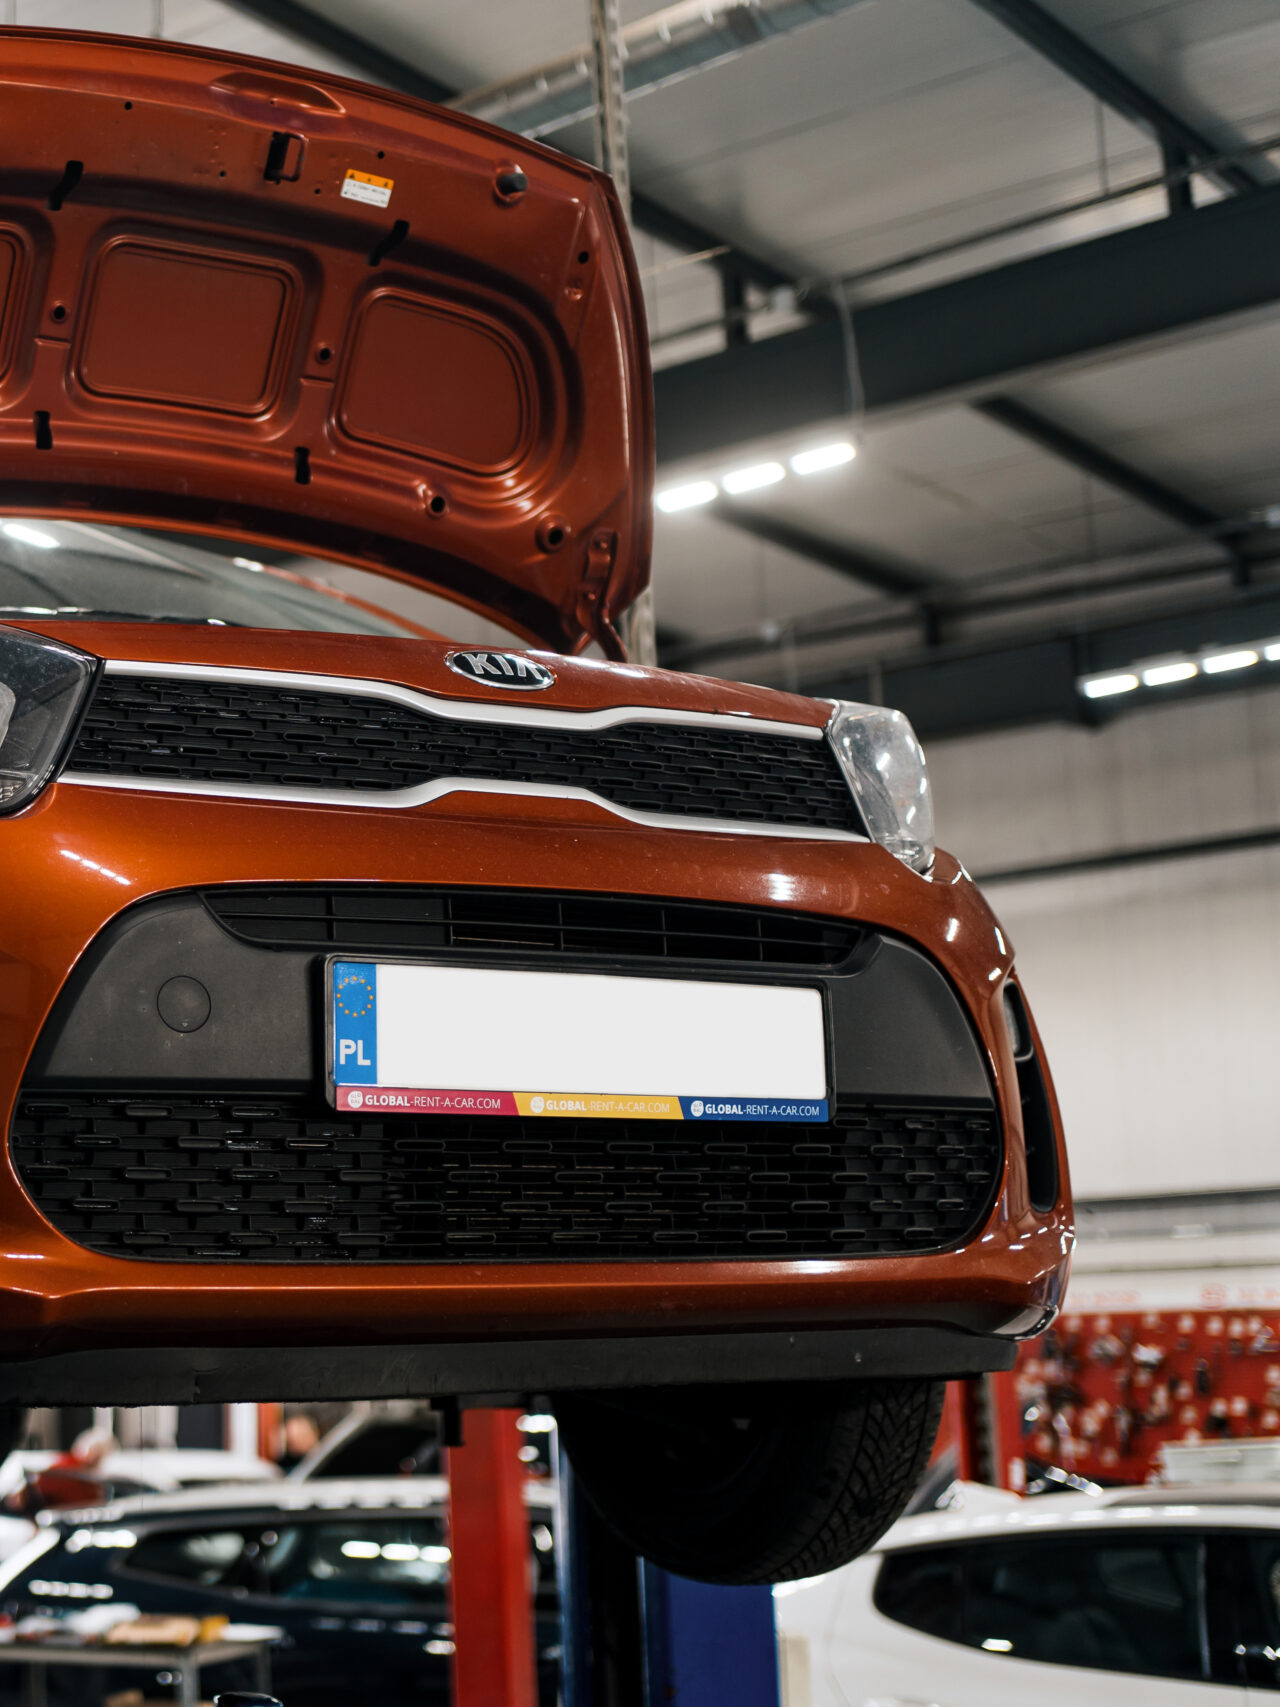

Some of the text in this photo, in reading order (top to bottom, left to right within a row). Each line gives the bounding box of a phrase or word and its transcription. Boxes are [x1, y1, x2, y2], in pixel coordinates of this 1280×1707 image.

[462, 653, 544, 681] KIA
[339, 1039, 371, 1066] PL
[365, 1094, 501, 1109] GLOBAL-RENT-A-CAR.COM
[546, 1099, 670, 1113] GLOBAL-RENT-A-CAR.COM
[705, 1103, 820, 1117] GLOBAL-RENT-A-CAR.COM
